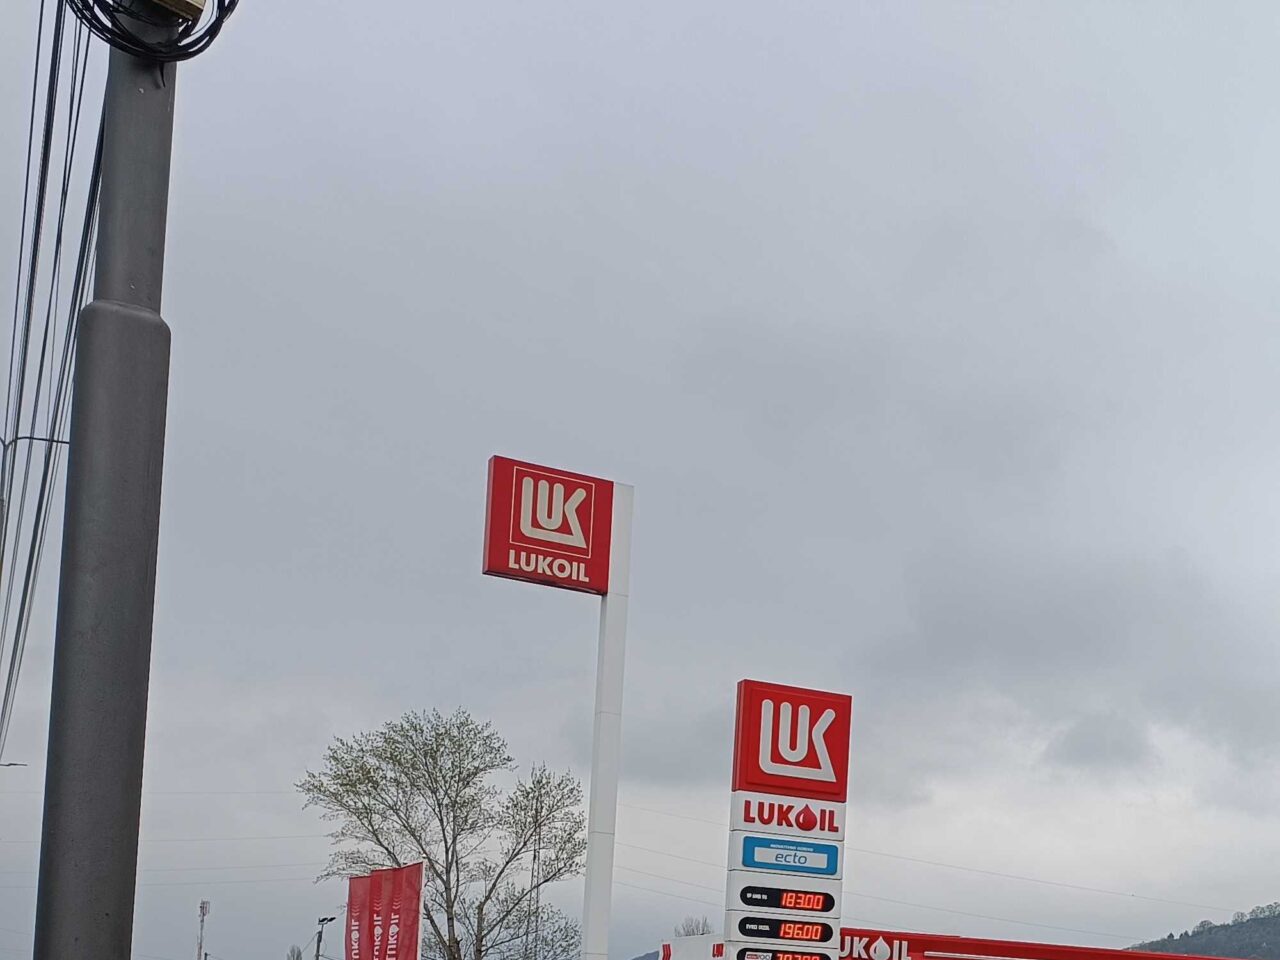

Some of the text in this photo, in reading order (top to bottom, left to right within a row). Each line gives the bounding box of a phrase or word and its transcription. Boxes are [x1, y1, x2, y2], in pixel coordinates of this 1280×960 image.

[508, 549, 589, 583] LUKOIL
[758, 699, 837, 783] LUK
[743, 799, 839, 833] LUKOIL
[774, 852, 807, 865] ecto
